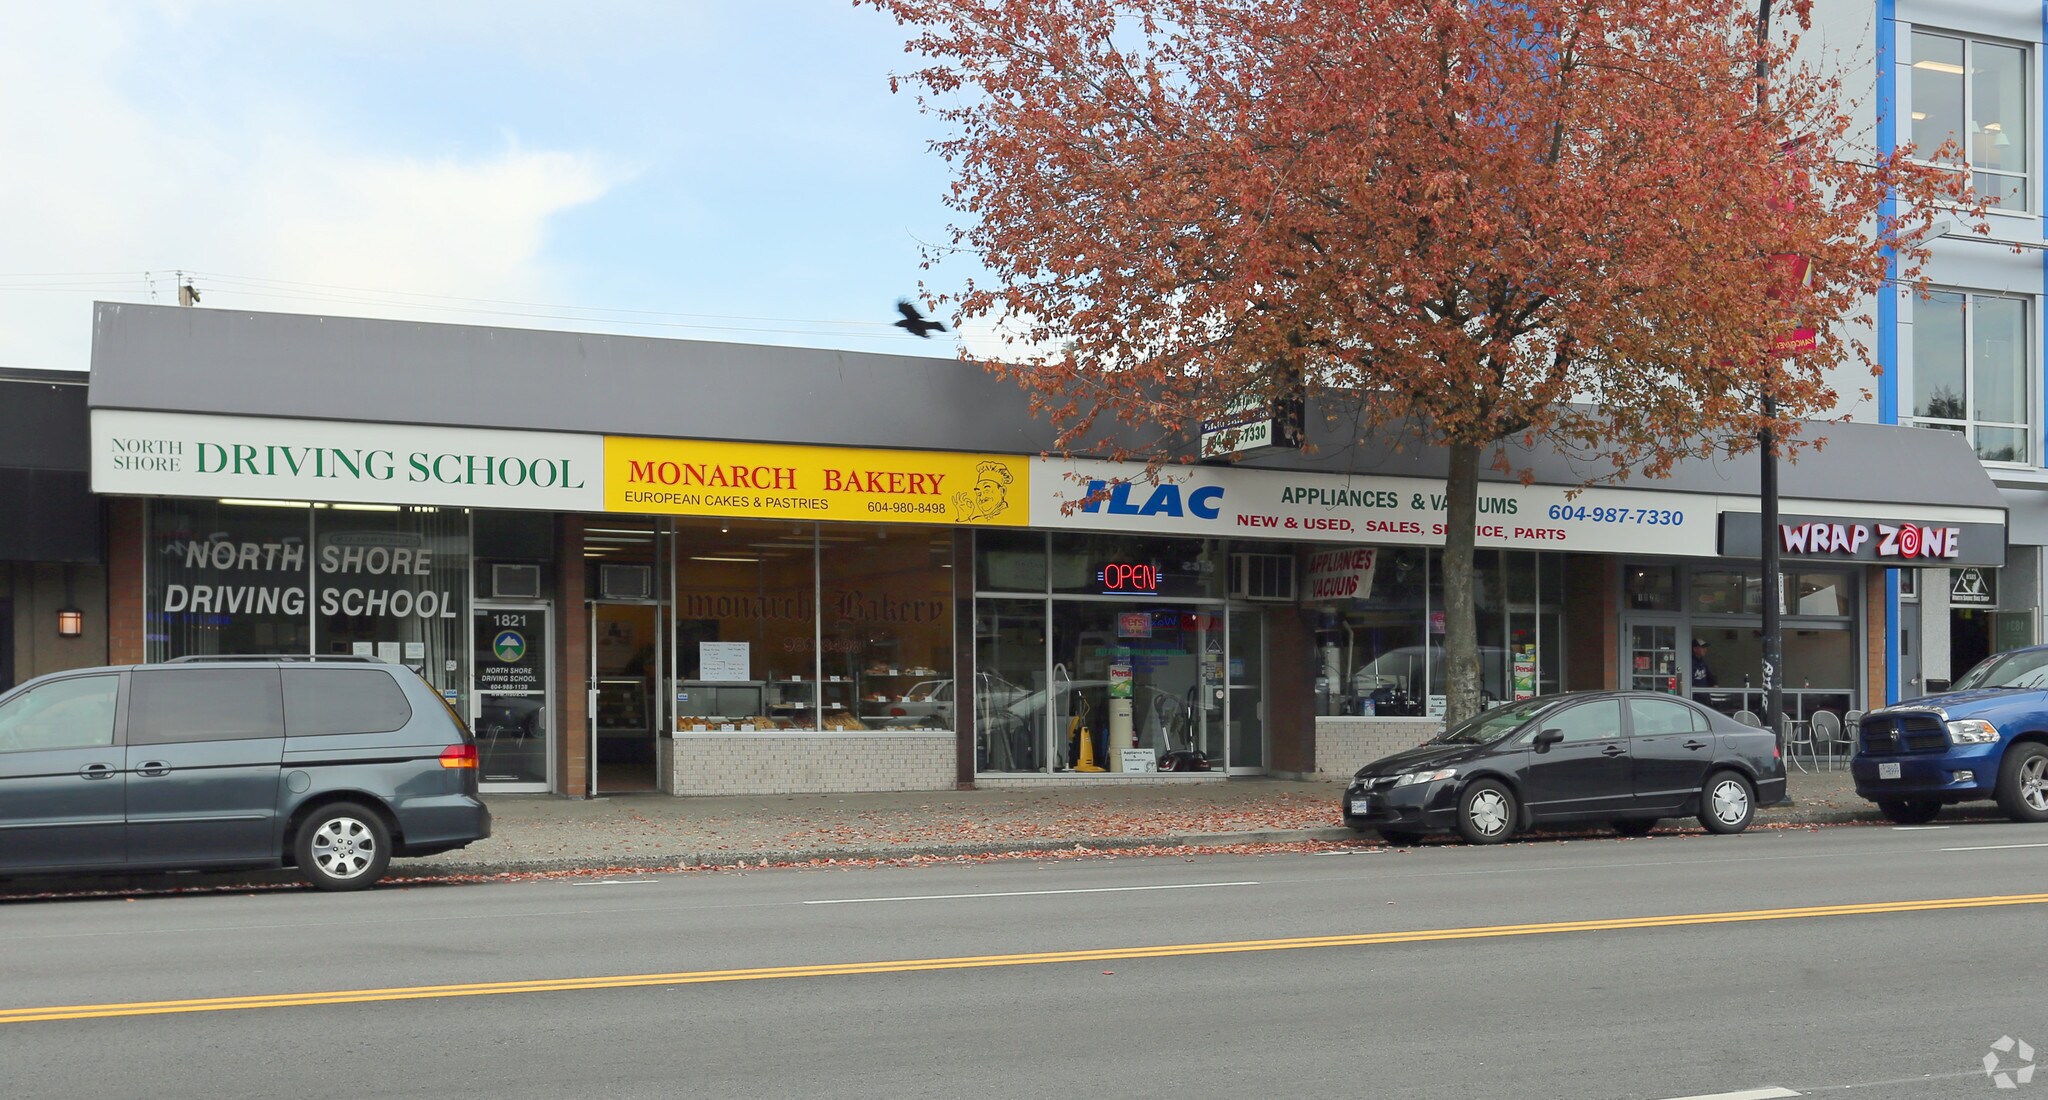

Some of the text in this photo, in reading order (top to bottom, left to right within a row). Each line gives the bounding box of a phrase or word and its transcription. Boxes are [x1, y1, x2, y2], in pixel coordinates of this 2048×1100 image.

[111, 438, 183, 455] NORTH
[113, 454, 182, 472] SHORE
[194, 442, 585, 489] DRIVING SCHOOL
[628, 460, 945, 496] MONARCH BAKERY
[625, 491, 829, 510] EUROPEAN CAKES & PASTRIES
[867, 502, 946, 515] 604-980-8498
[1081, 480, 1225, 519] ILAC
[1281, 486, 1399, 509] APPLIANCES
[1410, 493, 1426, 510] &
[1548, 505, 1684, 526] 604-987-7330
[1236, 515, 1280, 531] NEW
[1284, 517, 1299, 531] &
[1303, 518, 1355, 535] USED,
[1366, 520, 1425, 537] SALES,
[1514, 527, 1566, 542] PARTS
[1779, 523, 1960, 558] WRAP ZONE
[185, 541, 304, 571] NORTH
[320, 545, 433, 576] SHORE
[1309, 549, 1373, 574] APPLIANCES
[1104, 563, 1156, 590] OPEN
[164, 584, 457, 619] DRIVING SCHOOL
[834, 590, 944, 627] Bakery
[493, 614, 526, 627] 1821
[1112, 669, 1132, 678] Persil
[1515, 665, 1535, 673] Persil
